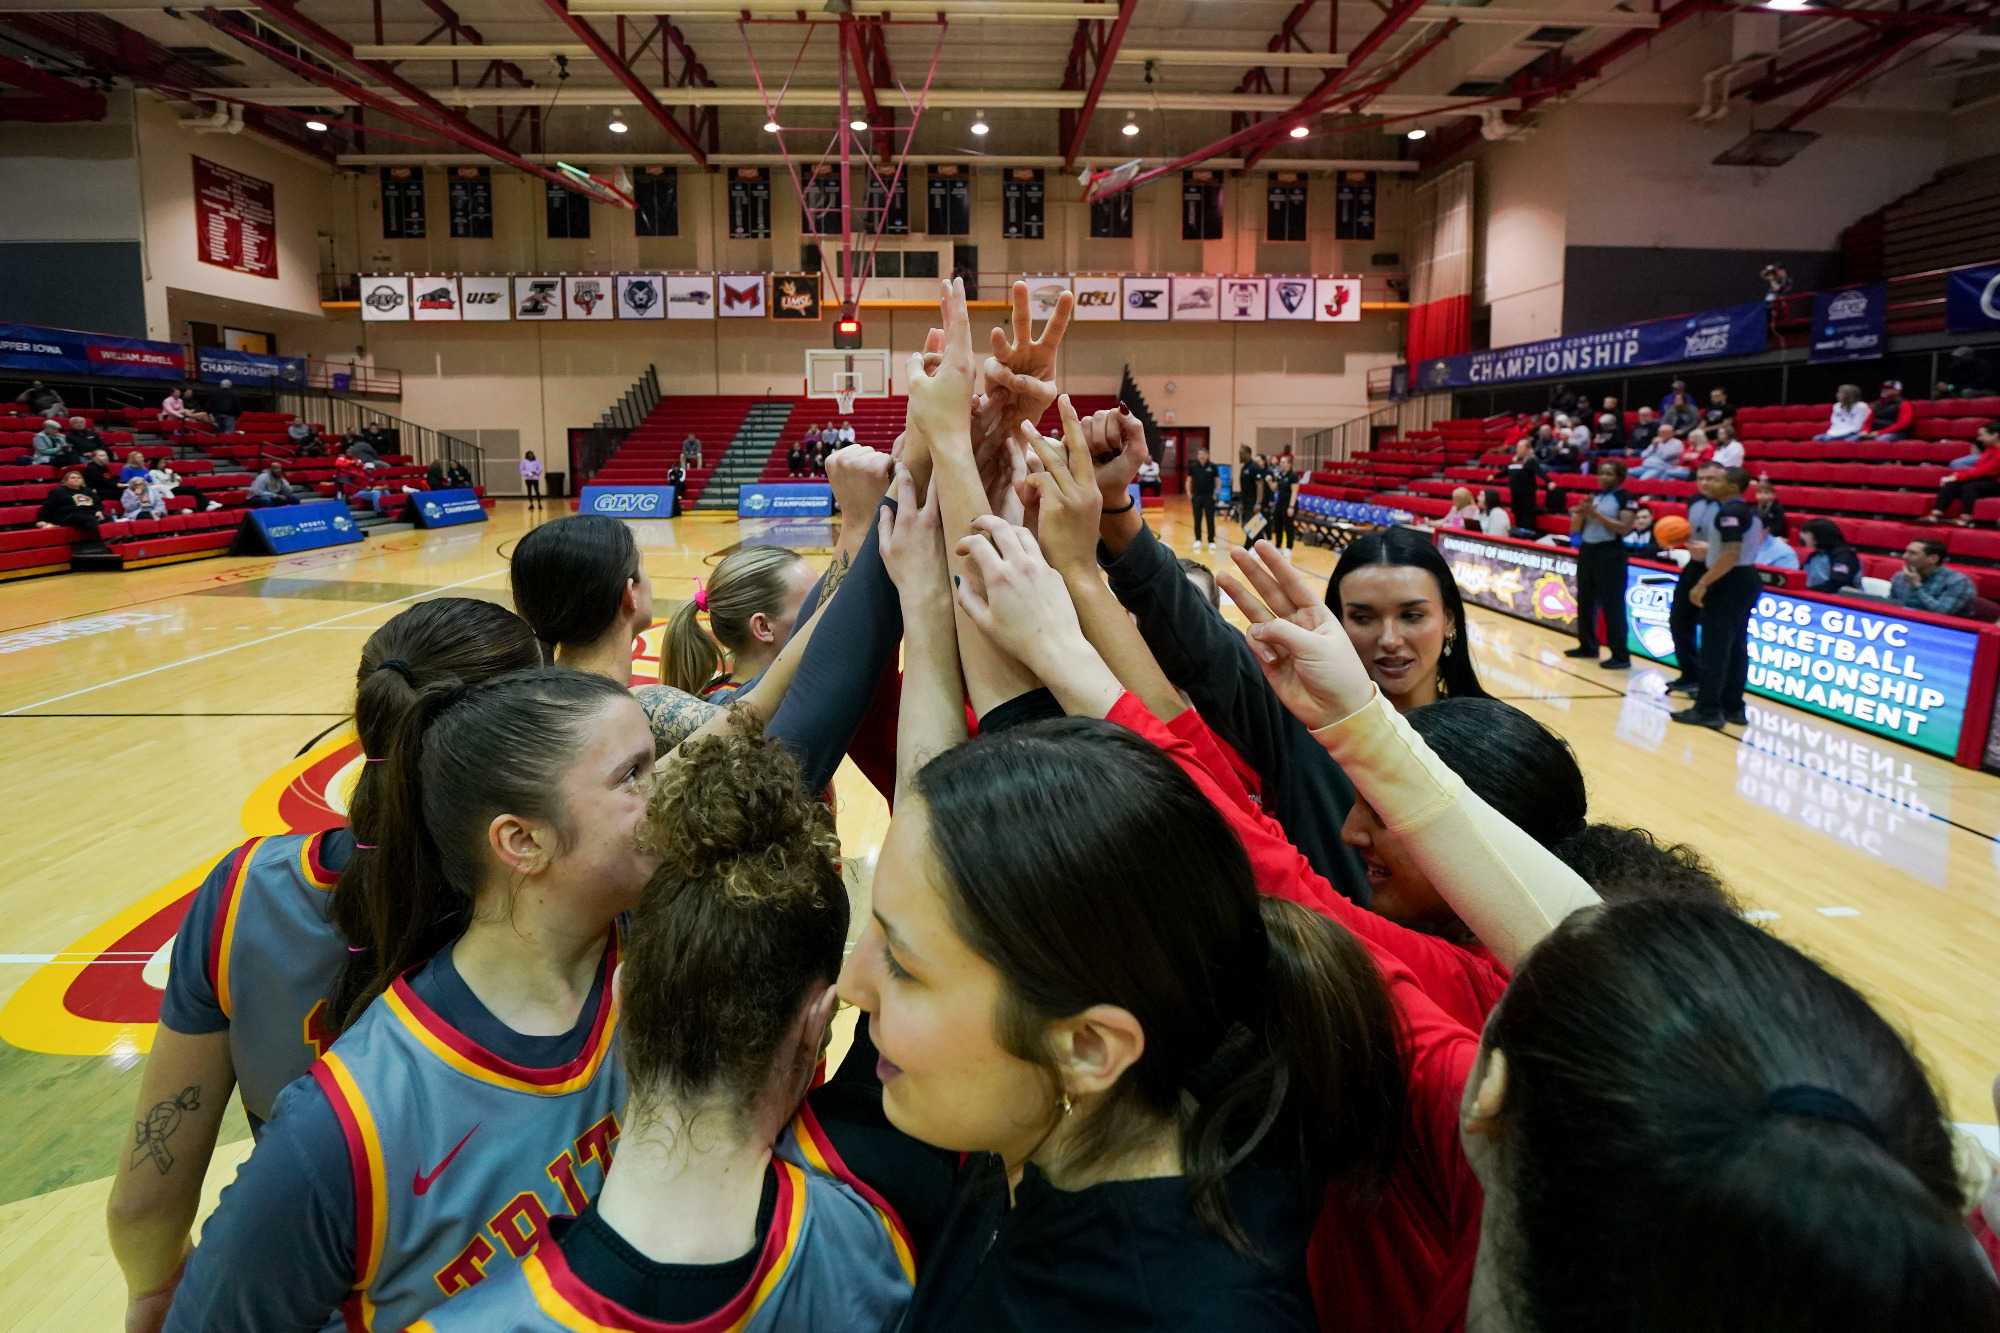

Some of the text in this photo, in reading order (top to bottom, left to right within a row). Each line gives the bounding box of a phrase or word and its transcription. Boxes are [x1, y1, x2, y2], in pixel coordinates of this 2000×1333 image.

[466, 292, 499, 305] UIS
[723, 282, 761, 311] M
[1565, 328, 1640, 350] CONFERENCE
[100, 350, 140, 362] WILLIAM
[200, 361, 280, 379] CHAMPIONSHIP
[1468, 340, 1640, 383] CHAMPIONSHIP
[594, 493, 659, 513] GLVC
[773, 500, 829, 508] CHAMPIONSHIP
[298, 519, 326, 529] SPORTS
[1443, 537, 1578, 577] UNIVERSITY OF MISSOURI ST. LOU
[1453, 561, 1490, 592] UMSL
[1628, 586, 1673, 609] GLV
[1751, 597, 1908, 648] 026 GLVC
[1747, 616, 1924, 681] ASKETBALL
[1747, 641, 1945, 712] AMPIONSHIP
[1747, 663, 1927, 736] URNAMENT
[433, 1110, 623, 1298] TRIT
